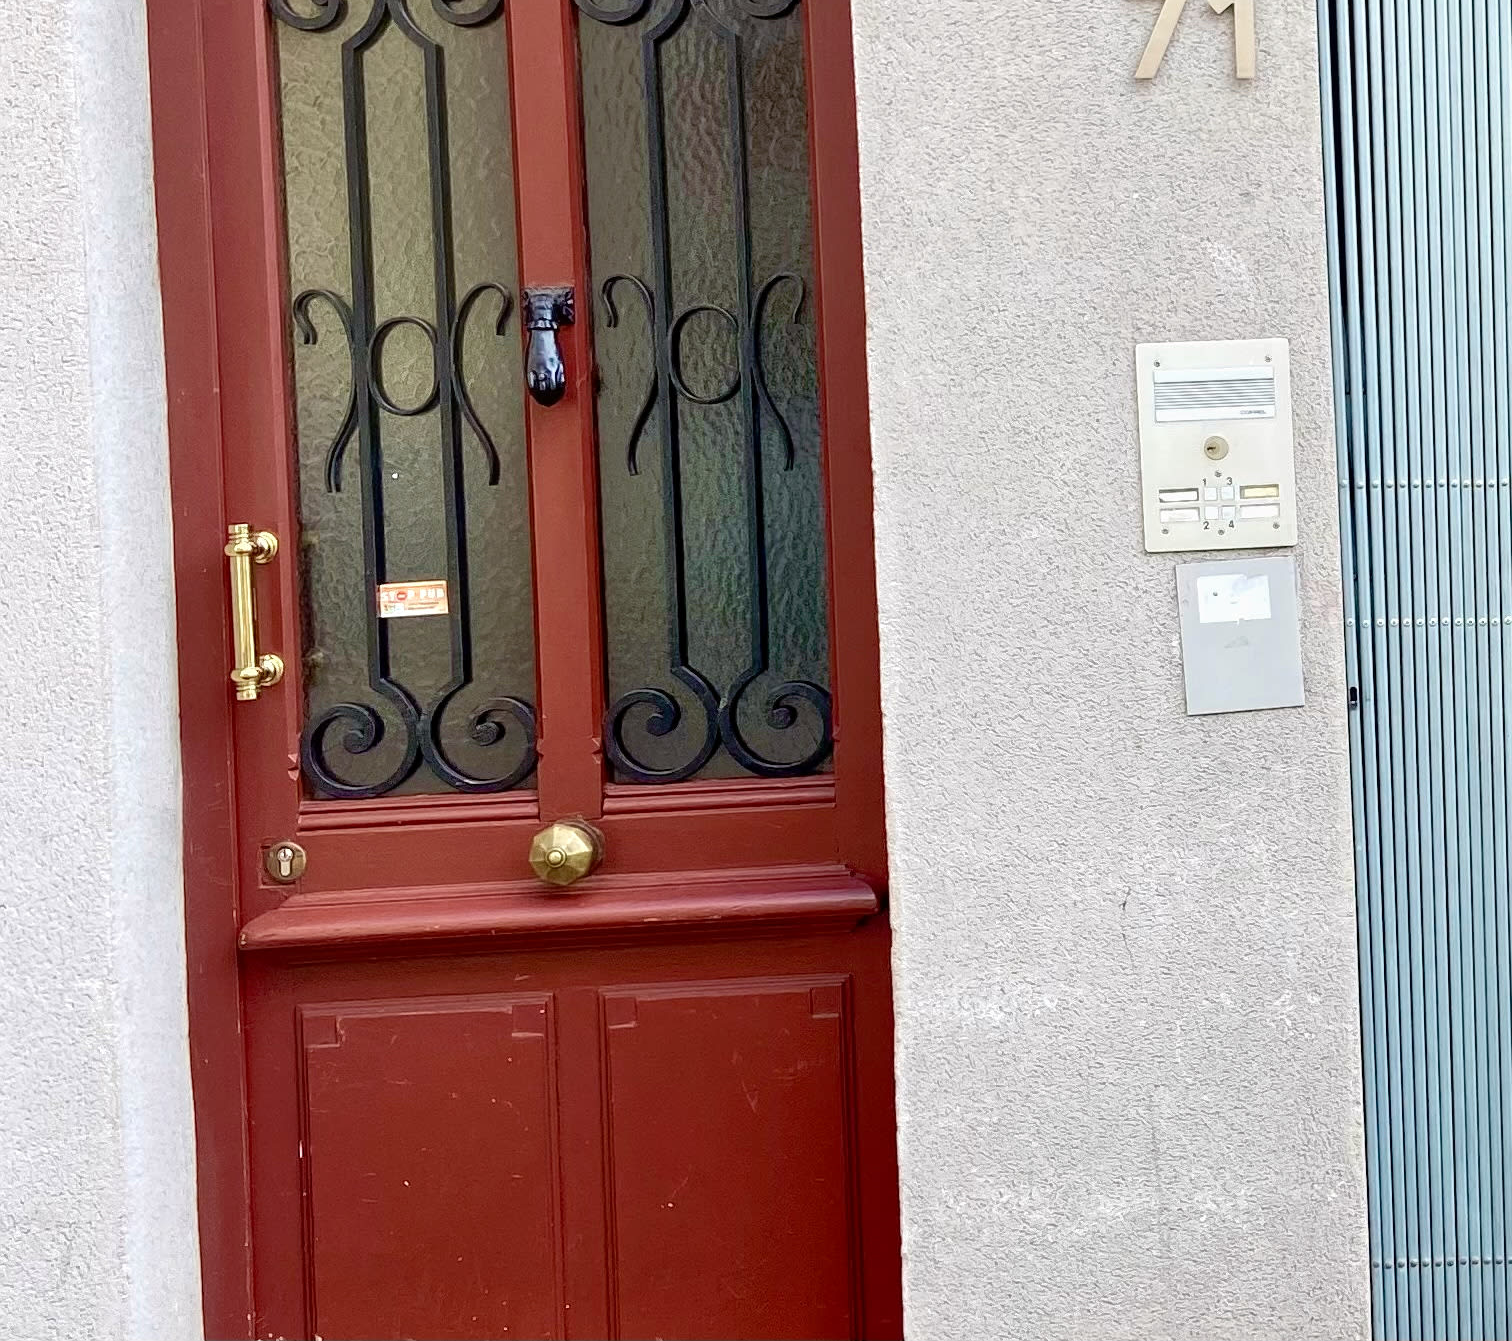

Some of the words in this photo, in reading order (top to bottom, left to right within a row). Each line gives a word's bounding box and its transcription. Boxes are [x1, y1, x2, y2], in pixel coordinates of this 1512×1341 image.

[1202, 478, 1208, 487] 1
[1226, 476, 1233, 486] 3
[1203, 520, 1210, 530] 2
[1228, 520, 1235, 529] 4
[419, 587, 445, 599] PUB
